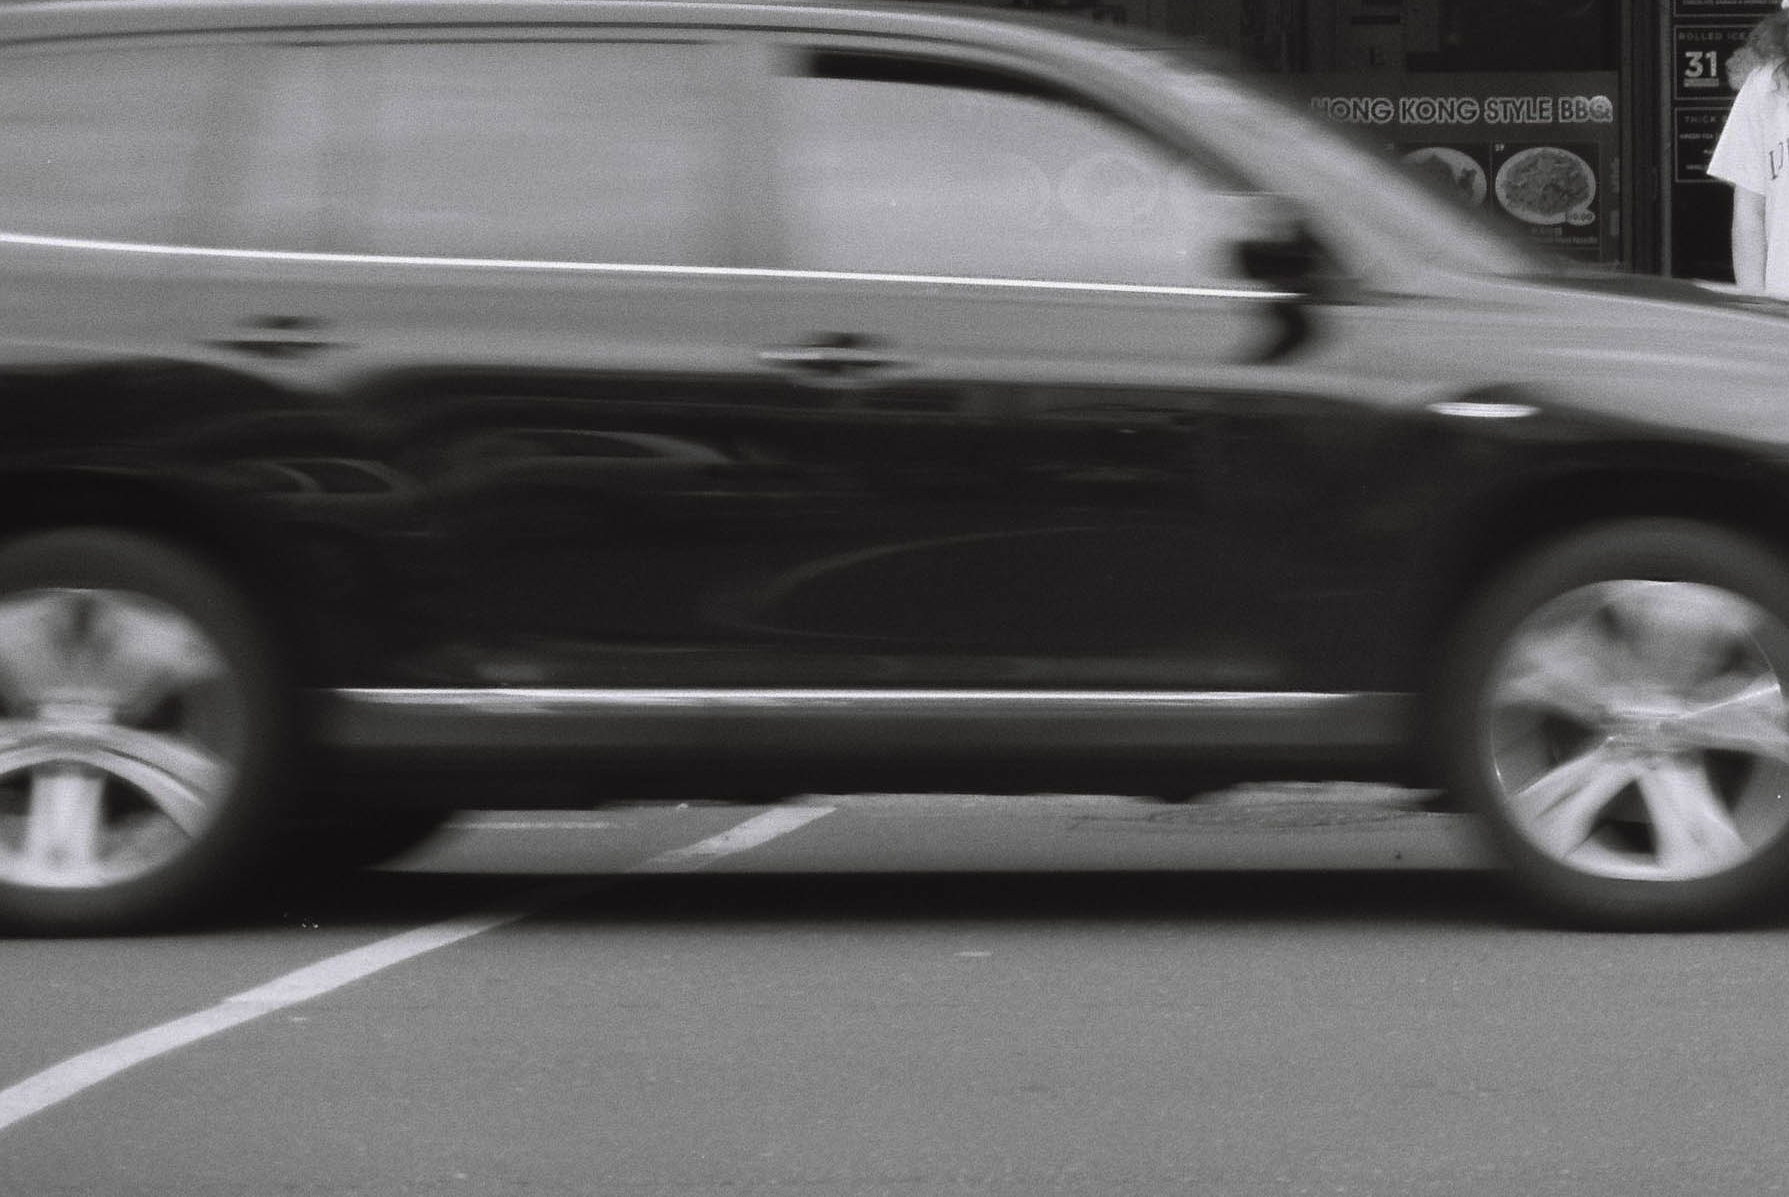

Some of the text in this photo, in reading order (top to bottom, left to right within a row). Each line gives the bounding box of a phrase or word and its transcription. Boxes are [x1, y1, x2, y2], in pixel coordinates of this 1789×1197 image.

[1684, 50, 1718, 78] 31
[1398, 96, 1481, 124] KONG
[1484, 96, 1553, 124] STYLE
[1557, 94, 1614, 124] BBQ
